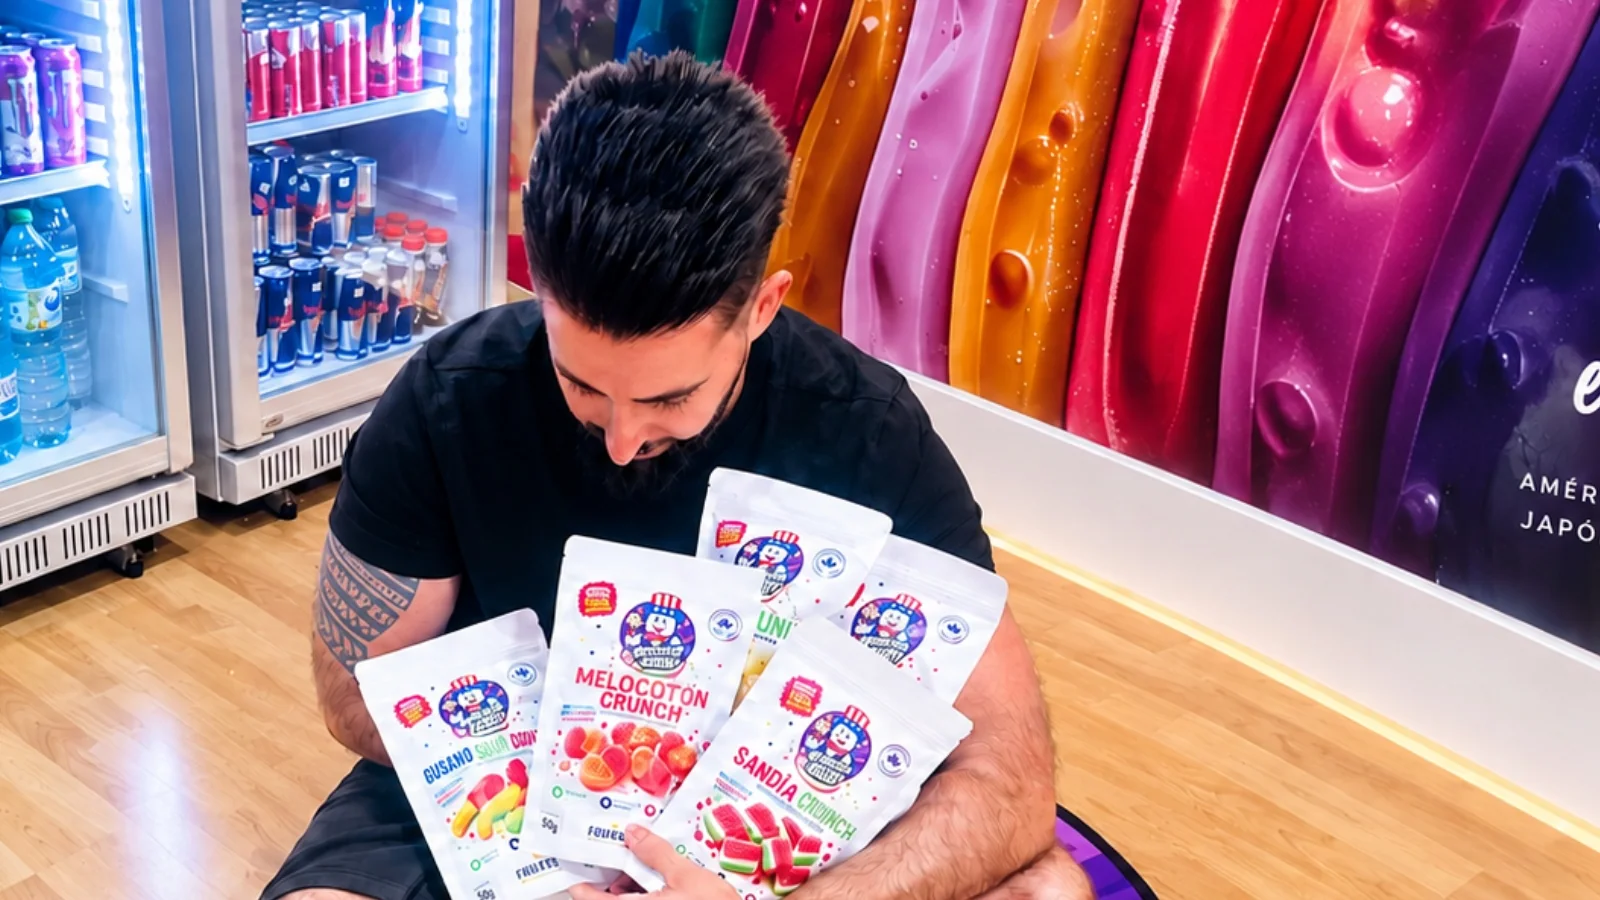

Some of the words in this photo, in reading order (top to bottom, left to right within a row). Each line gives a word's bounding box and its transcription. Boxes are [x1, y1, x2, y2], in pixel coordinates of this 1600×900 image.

[1519, 472, 1598, 505] AMÉR
[1520, 510, 1600, 543] JAPÓ
[600, 691, 683, 723] CRUNCH
[423, 747, 474, 785] GUSANO
[733, 746, 798, 802] SANDÍA
